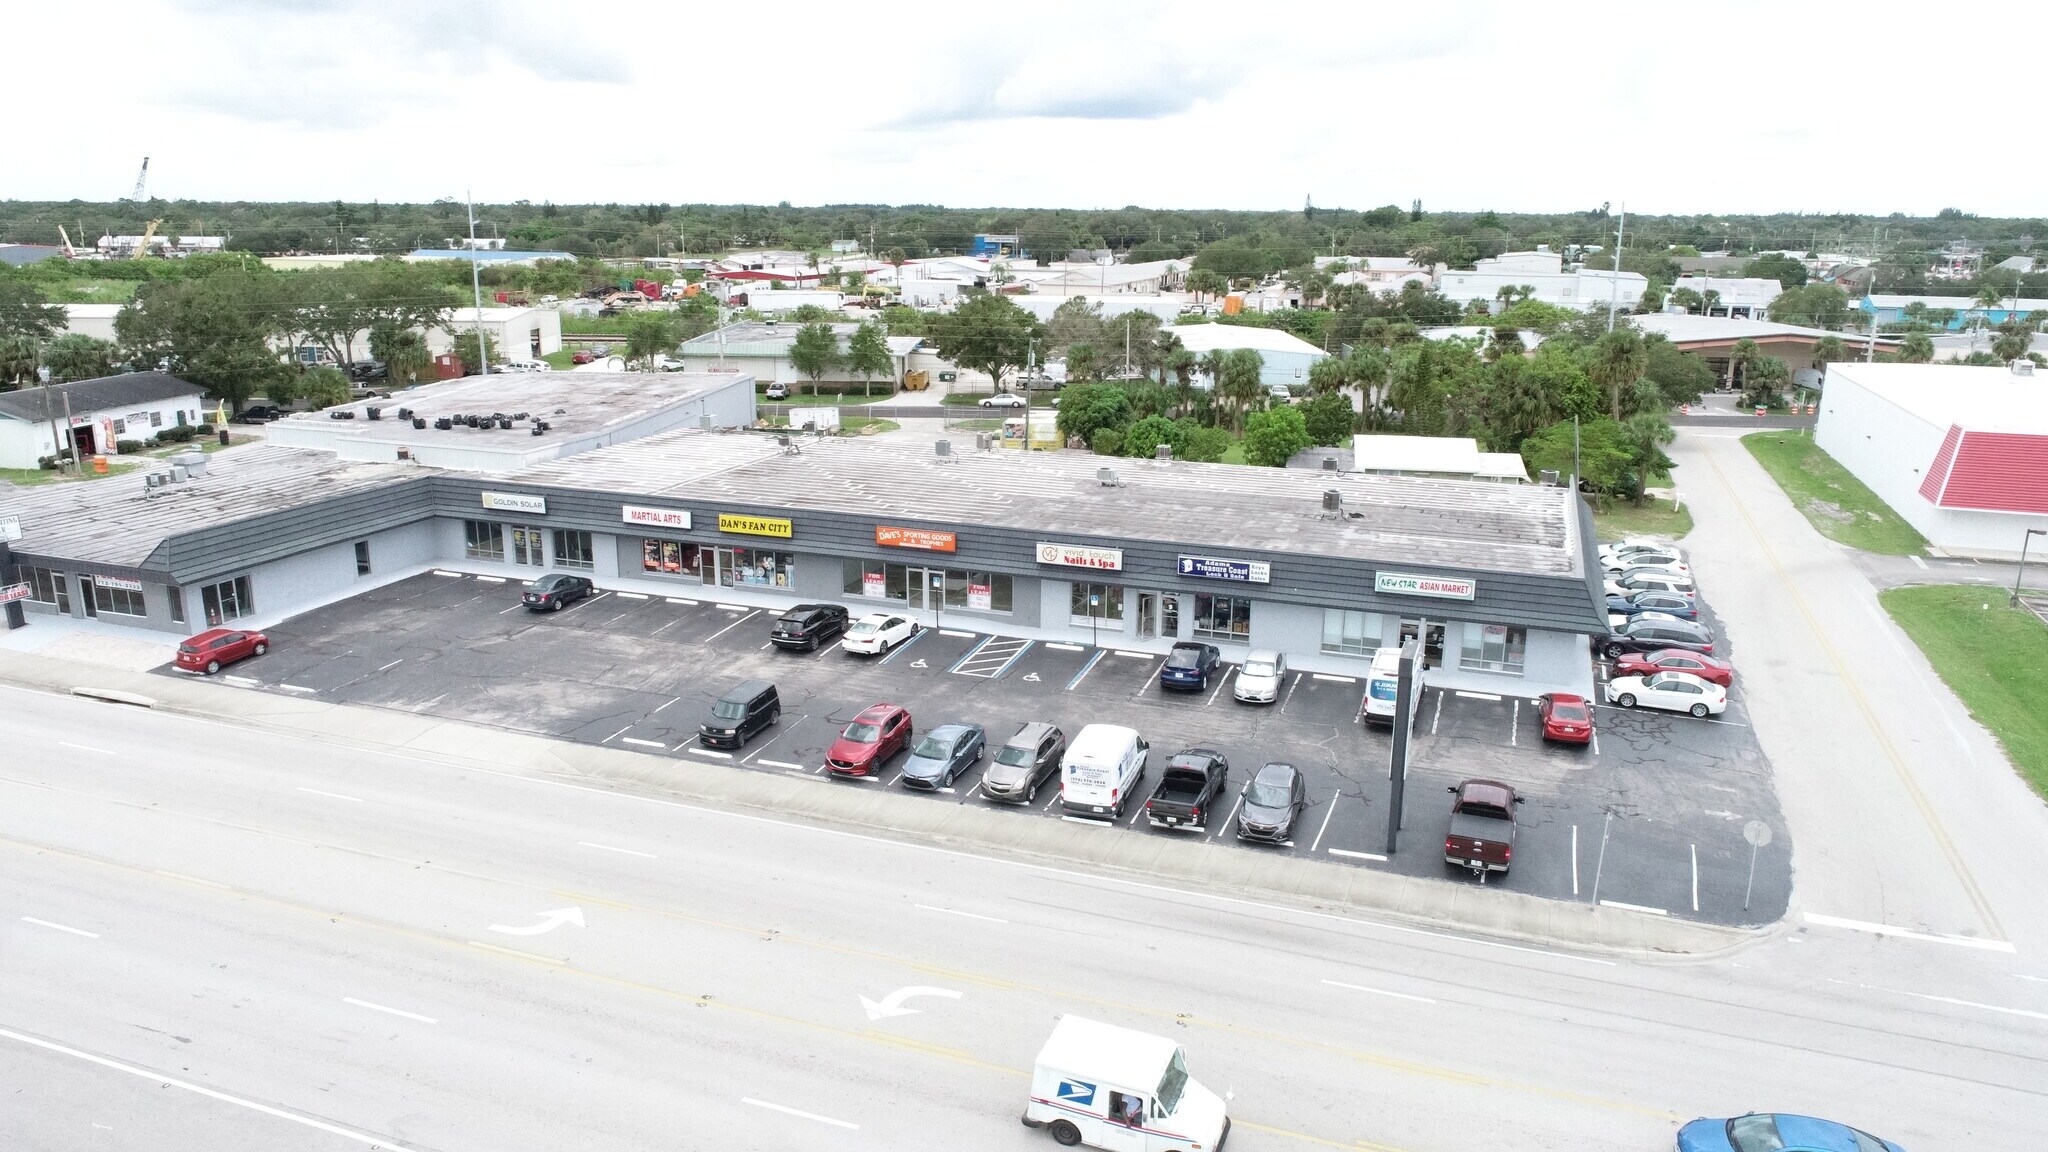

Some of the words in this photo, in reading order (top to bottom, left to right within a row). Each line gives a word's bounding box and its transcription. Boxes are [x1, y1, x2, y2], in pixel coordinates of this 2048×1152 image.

[493, 498, 519, 507] GOLDIN
[520, 501, 543, 509] SOLAR
[631, 510, 662, 523] MARTIAL
[663, 515, 682, 525] ARTS
[720, 518, 747, 530] DAN'S
[748, 521, 767, 532] FAN
[768, 523, 789, 533] CITY
[878, 530, 901, 540] DAVE'S
[903, 531, 931, 540] SPORTING
[931, 534, 953, 542] GOODS
[920, 539, 944, 547] TROPHIES
[1064, 548, 1085, 557] vivid
[1089, 550, 1115, 560] touch
[1064, 556, 1087, 566] Nails
[1089, 558, 1096, 567] &
[1098, 558, 1115, 569] Spa
[1196, 563, 1227, 573] Treasure
[1228, 566, 1248, 576] Coast
[1380, 578, 1397, 587] NEW
[1398, 579, 1418, 589] STAR
[1419, 582, 1440, 591] ASIAN
[1441, 583, 1469, 593] MARKET
